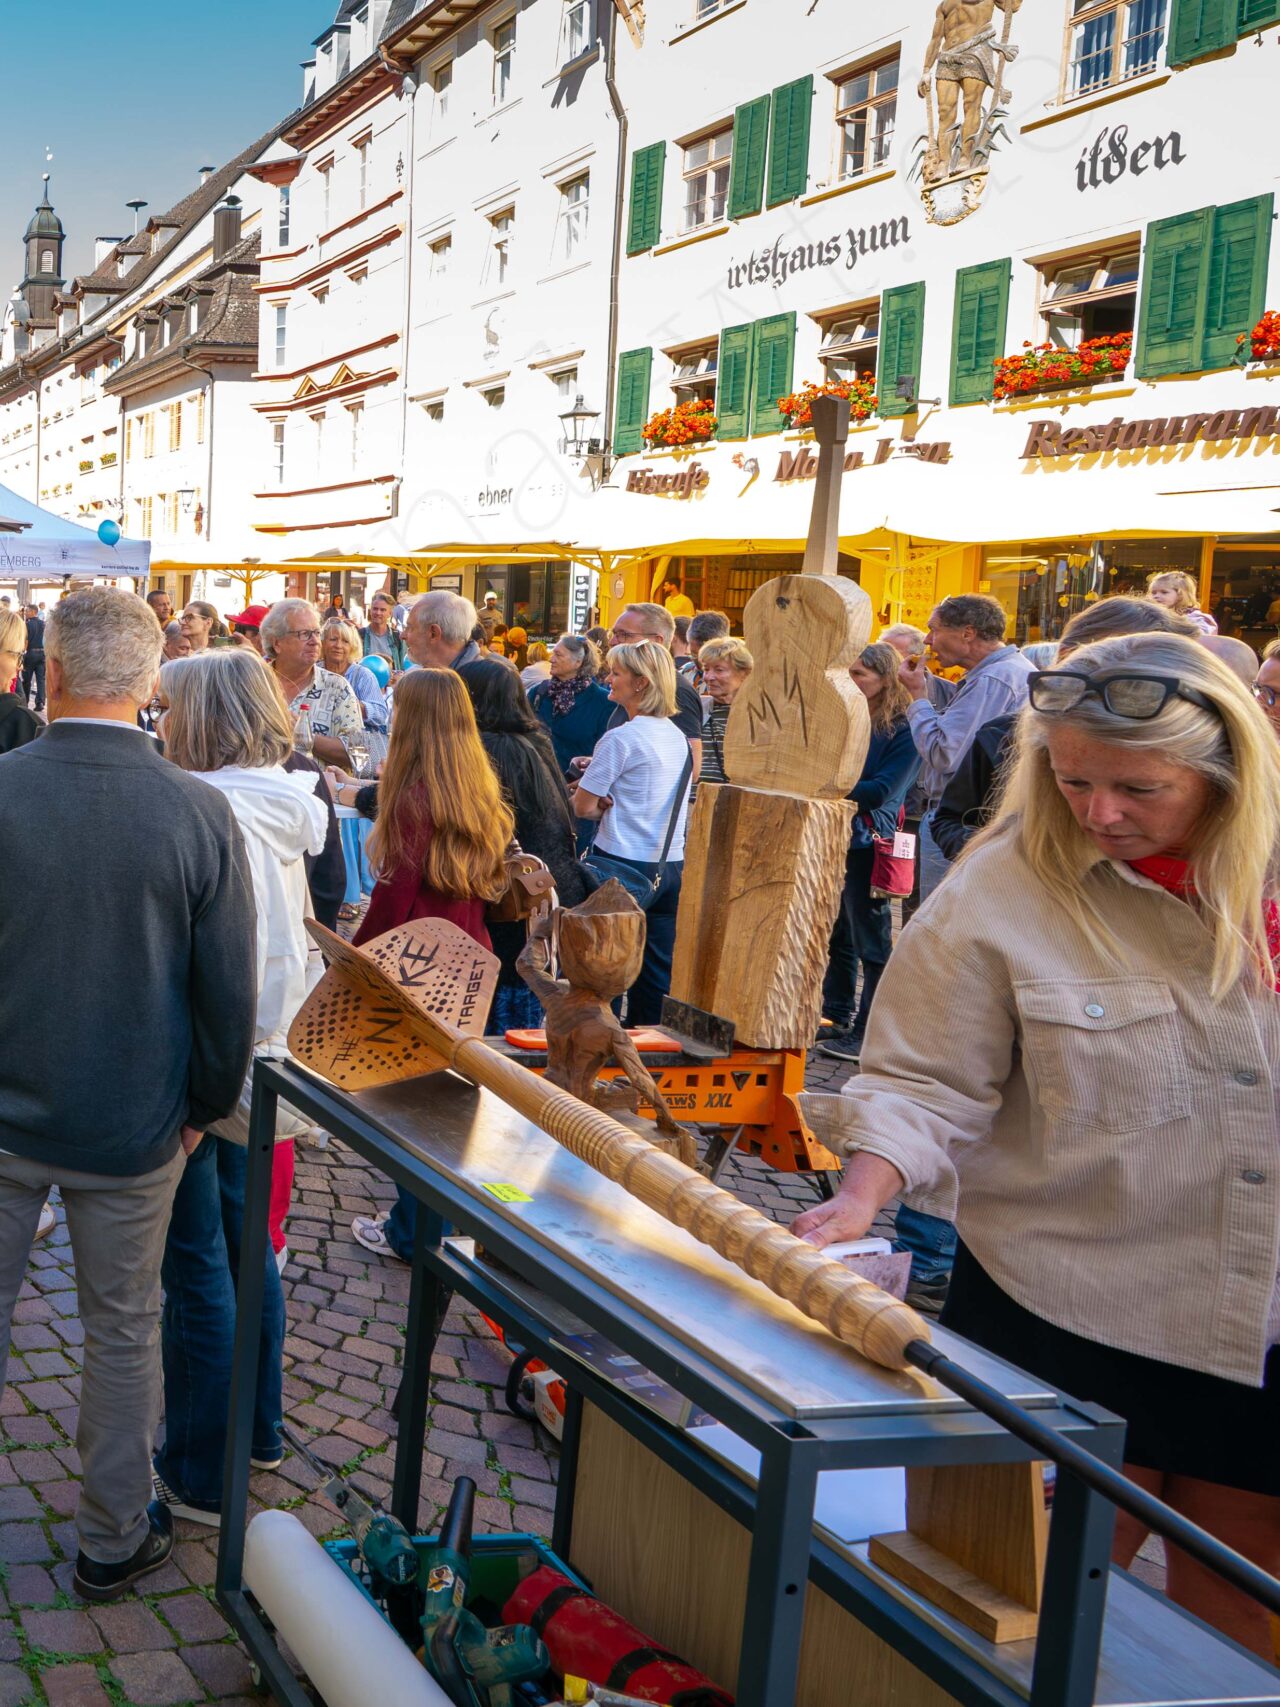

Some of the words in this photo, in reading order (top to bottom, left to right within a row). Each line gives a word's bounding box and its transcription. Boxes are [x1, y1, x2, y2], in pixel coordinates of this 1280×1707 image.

[845, 215, 912, 270] zum
[772, 446, 865, 482] Moa
[457, 958, 487, 1028] TARGET
[703, 1092, 734, 1109] XXL
